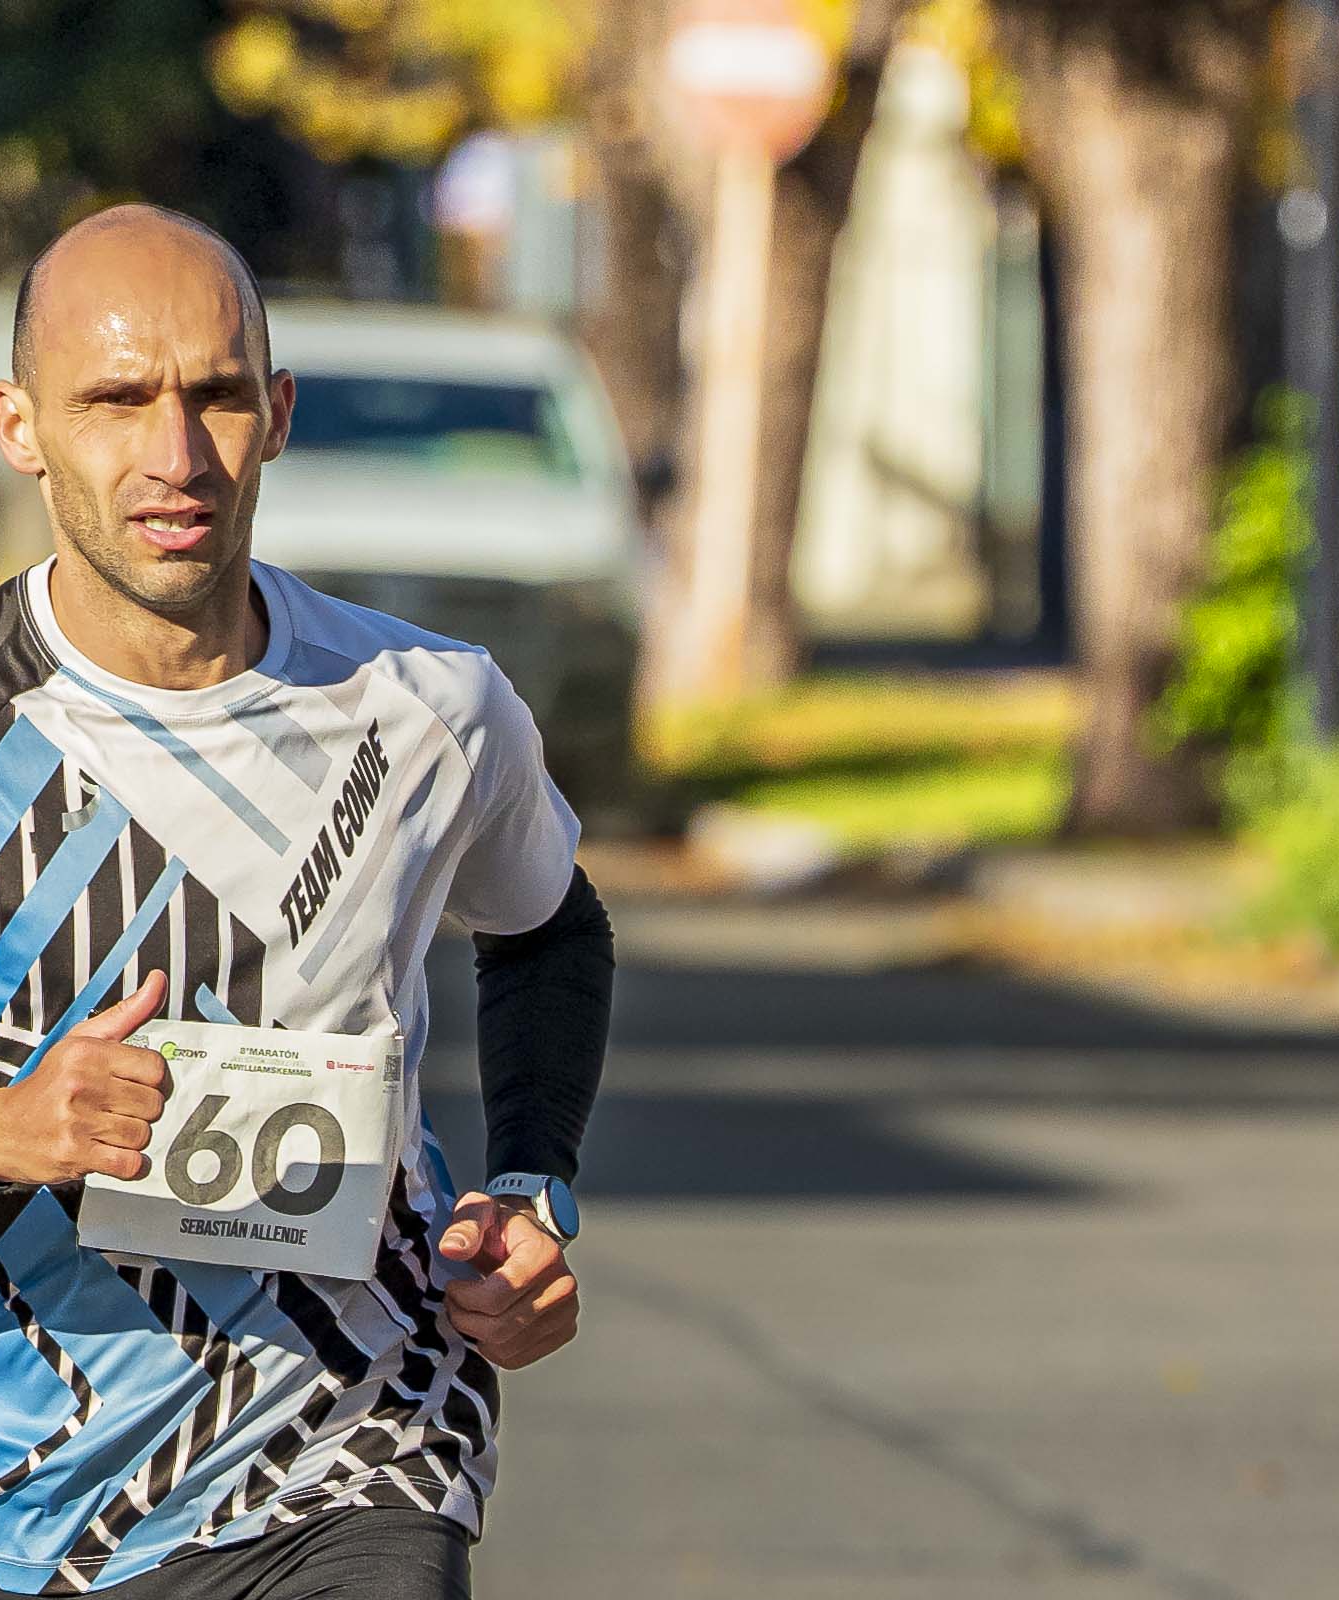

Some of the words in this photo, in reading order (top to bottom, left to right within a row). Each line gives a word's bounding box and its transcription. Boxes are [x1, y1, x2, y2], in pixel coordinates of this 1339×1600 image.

[279, 824, 342, 950] TEAM
[332, 717, 390, 858] CONDE
[164, 1094, 346, 1216] 60
[180, 1218, 248, 1238] SEBASTIÁN
[250, 1223, 309, 1246] ALLENDE
